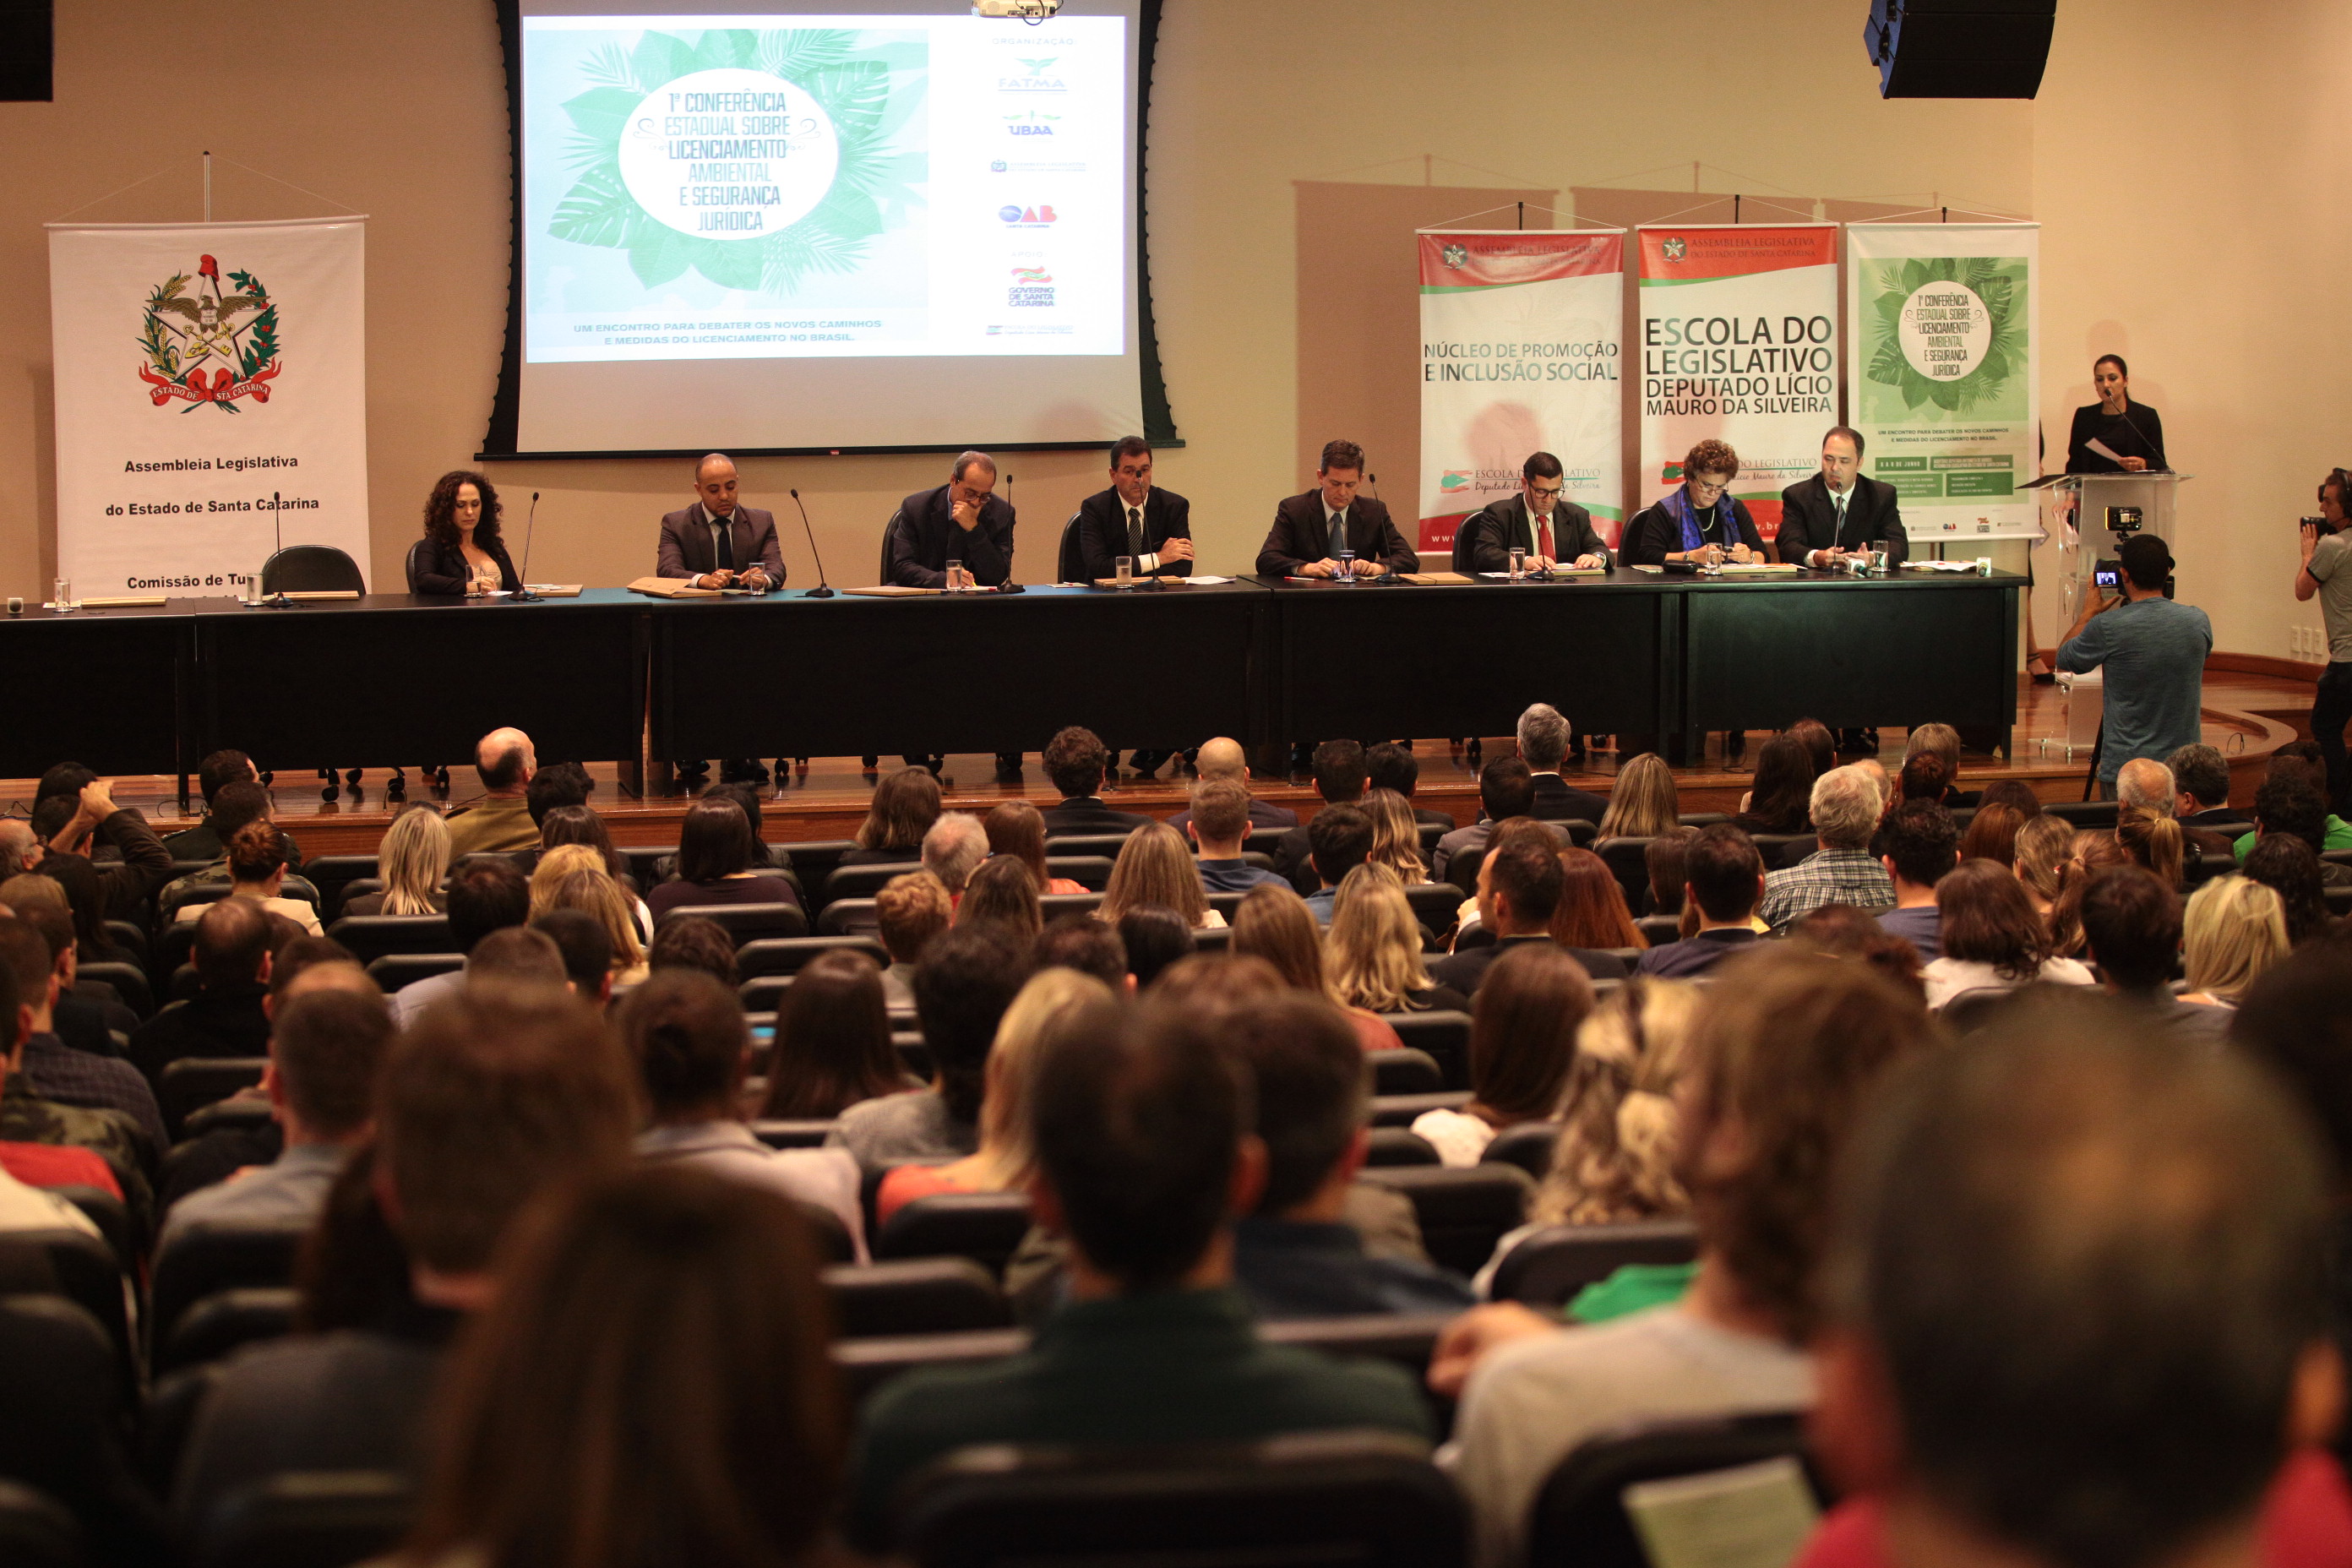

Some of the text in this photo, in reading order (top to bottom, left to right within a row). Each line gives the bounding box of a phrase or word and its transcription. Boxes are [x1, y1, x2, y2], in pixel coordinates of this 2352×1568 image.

[998, 78, 1065, 88] FATMA
[668, 88, 787, 112] 1ª CONFERÊNCIA
[665, 116, 791, 136] ESTADUAL SOBRE
[1008, 125, 1054, 135] UBAA
[668, 139, 787, 159] LICENCIAMENTO
[689, 162, 772, 182] AMBIENTAL
[679, 186, 781, 209] E SEGURANÇA
[698, 207, 763, 231] JURÍDICA
[999, 205, 1058, 222] OAB
[1691, 237, 1816, 248] ASSEMBLEIA LEGISLATIVA
[1750, 249, 1775, 258] SANTA
[1776, 249, 1816, 258] CATARINA
[1925, 292, 1968, 307] CONFERÊNCIA
[1917, 308, 1971, 320] ESTADUAL SOBRE
[574, 324, 593, 333] UM
[596, 324, 661, 332] ENCONTRO
[663, 323, 695, 331] PARA
[699, 322, 752, 330] DEBATER
[774, 321, 815, 329] NOVOS
[819, 320, 881, 329] CAMINHOS
[1646, 315, 1832, 346] ESCOLA DO
[1919, 322, 1969, 334] LICENCIAMENTO
[604, 333, 855, 346] E MEDIDAS DO LICENCIAMENTO NO BRASIL.
[1927, 336, 1963, 348] AMBIENTAL
[1424, 340, 1618, 361] NÚCLEO DE PROMOÇÃO
[1924, 349, 1968, 363] E SEGURANÇA
[1646, 346, 1832, 375] LEGISLATIVO
[1424, 360, 1618, 381] E INCLUSÃO SOCIAL
[1932, 362, 1960, 376] JURÍDICA
[152, 387, 185, 398] ESTADO
[186, 391, 199, 400] DE
[233, 384, 268, 397] CATARINA
[1647, 373, 1832, 398] DEPUTADO LÍCIO
[1647, 396, 1832, 416] MAURO DA SILVEIRA
[124, 456, 298, 472] Assembleia Legislativa
[1755, 458, 1817, 468] LEGISLATIVO
[1476, 470, 1514, 479] ESCOLA
[1475, 482, 1511, 494] Deputado
[106, 504, 123, 516] do
[128, 502, 180, 515] Estado
[185, 501, 203, 513] de
[208, 500, 251, 513] Santa
[128, 575, 200, 589] Comissão
[205, 574, 223, 586] de
